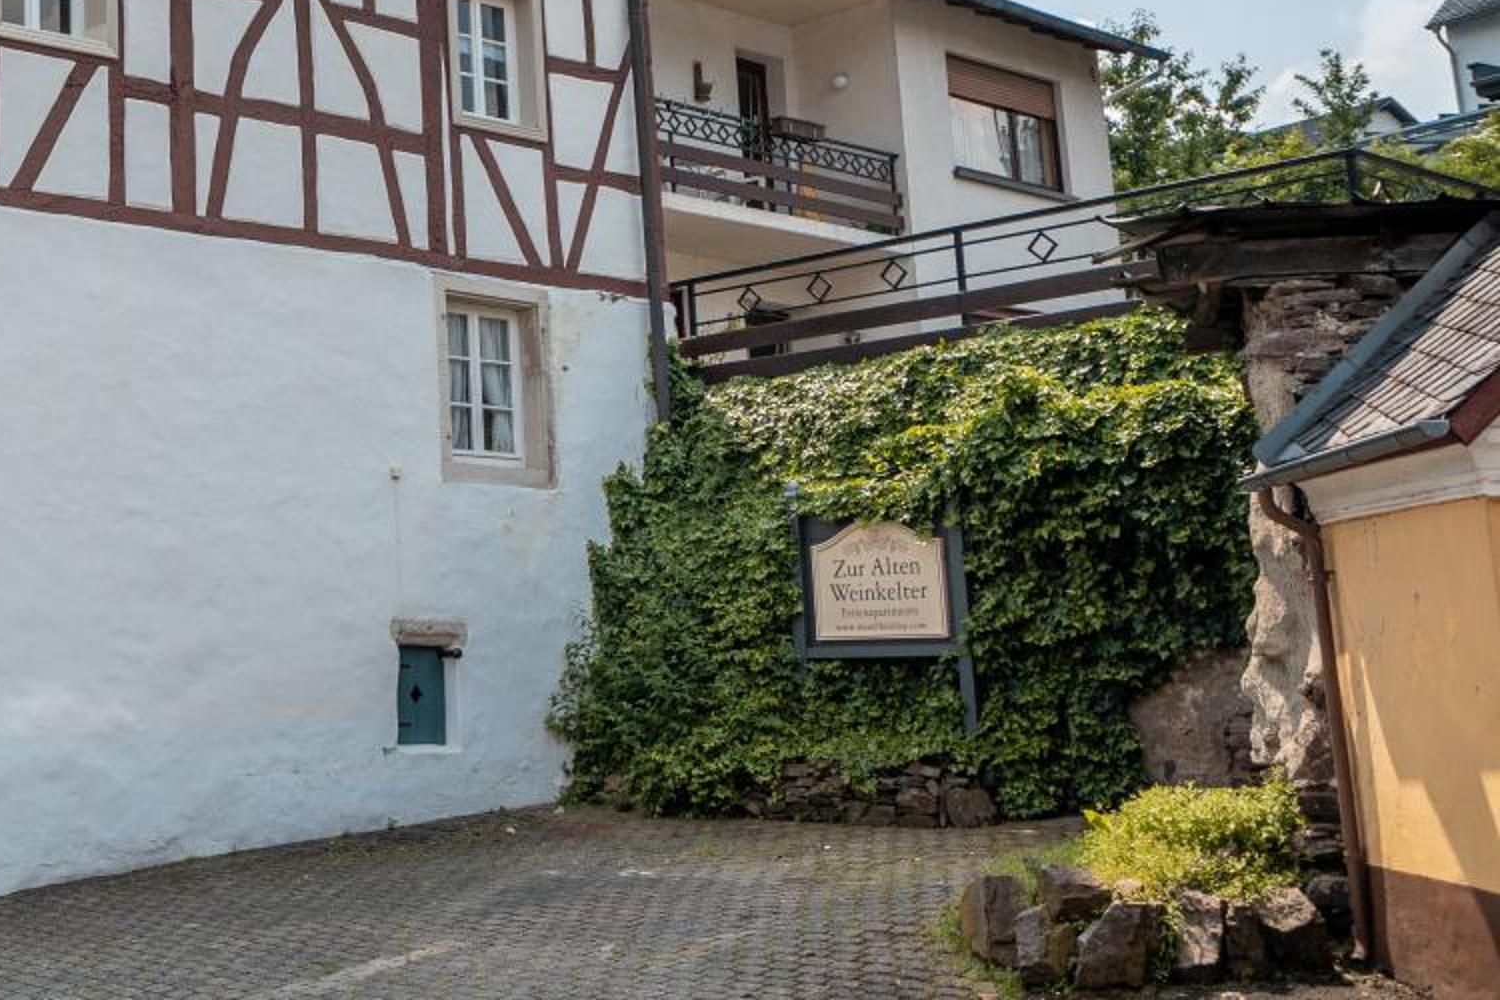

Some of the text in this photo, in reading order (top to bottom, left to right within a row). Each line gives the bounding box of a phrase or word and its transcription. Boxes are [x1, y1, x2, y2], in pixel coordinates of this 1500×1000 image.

[833, 556, 921, 579] Zur Alten
[829, 581, 929, 602] Weinkelter
